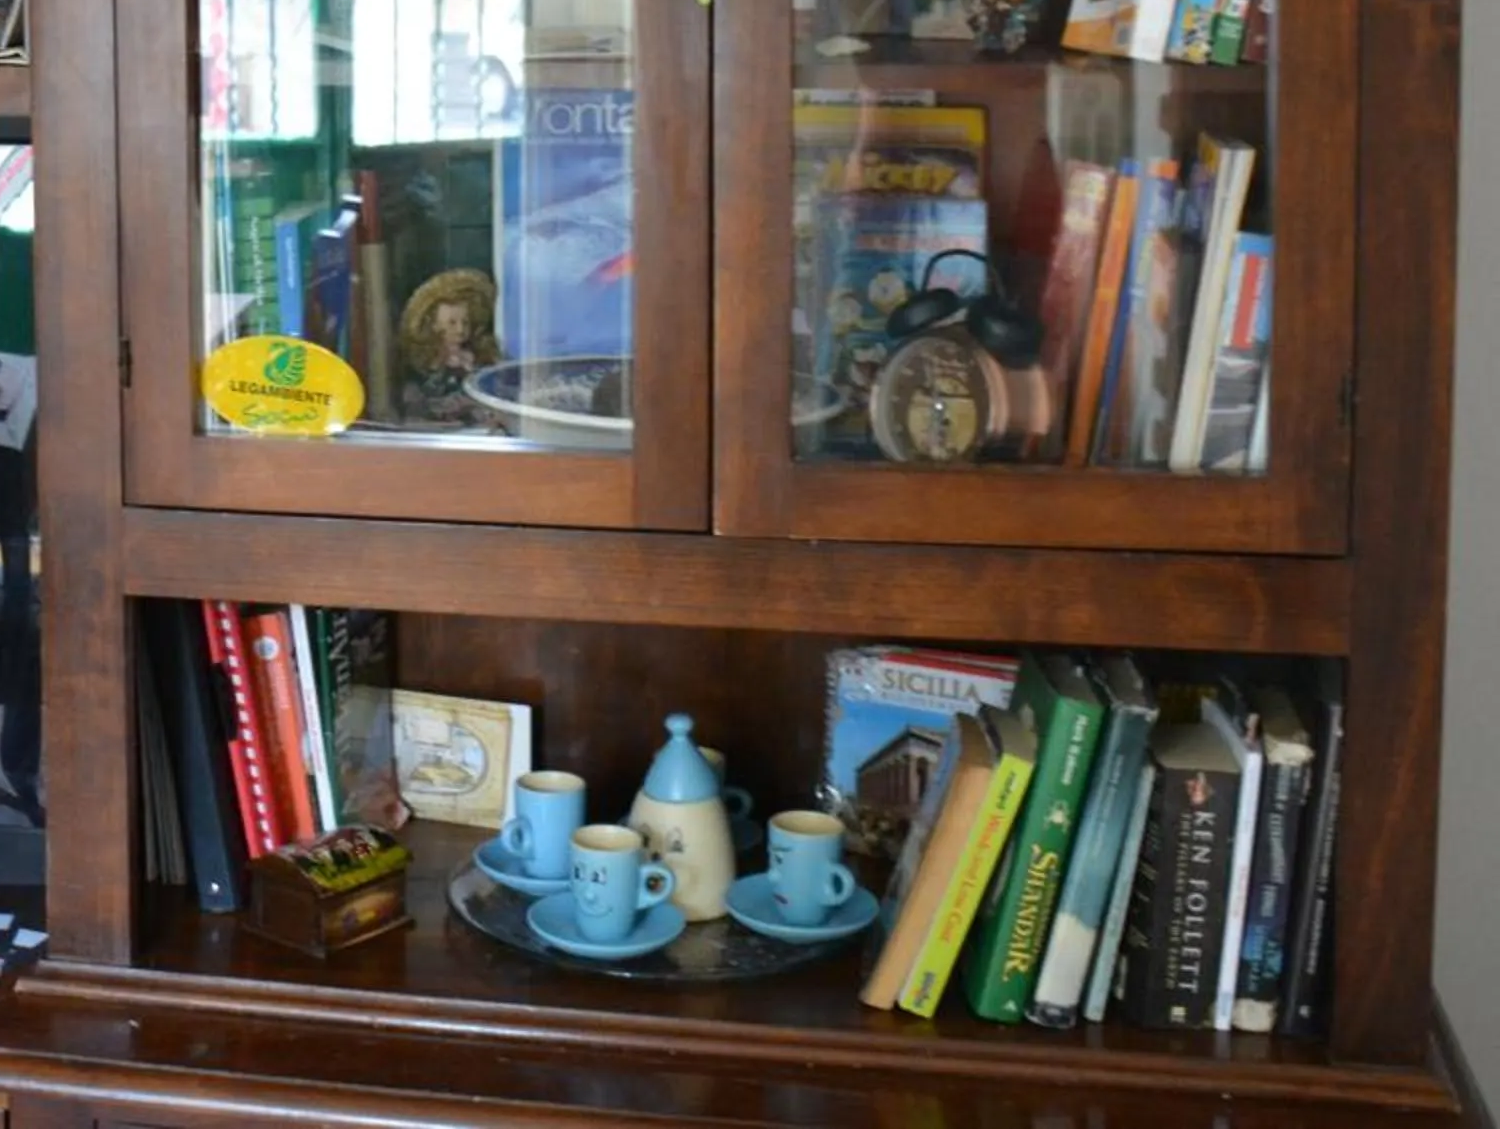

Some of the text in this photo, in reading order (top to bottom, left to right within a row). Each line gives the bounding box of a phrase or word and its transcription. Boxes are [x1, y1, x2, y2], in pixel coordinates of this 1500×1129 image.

[229, 379, 333, 406] LEGAMBIENTE
[881, 668, 981, 702] SICILIA
[1178, 813, 1192, 837] THE
[1177, 810, 1216, 994] KEN FOLLETT
